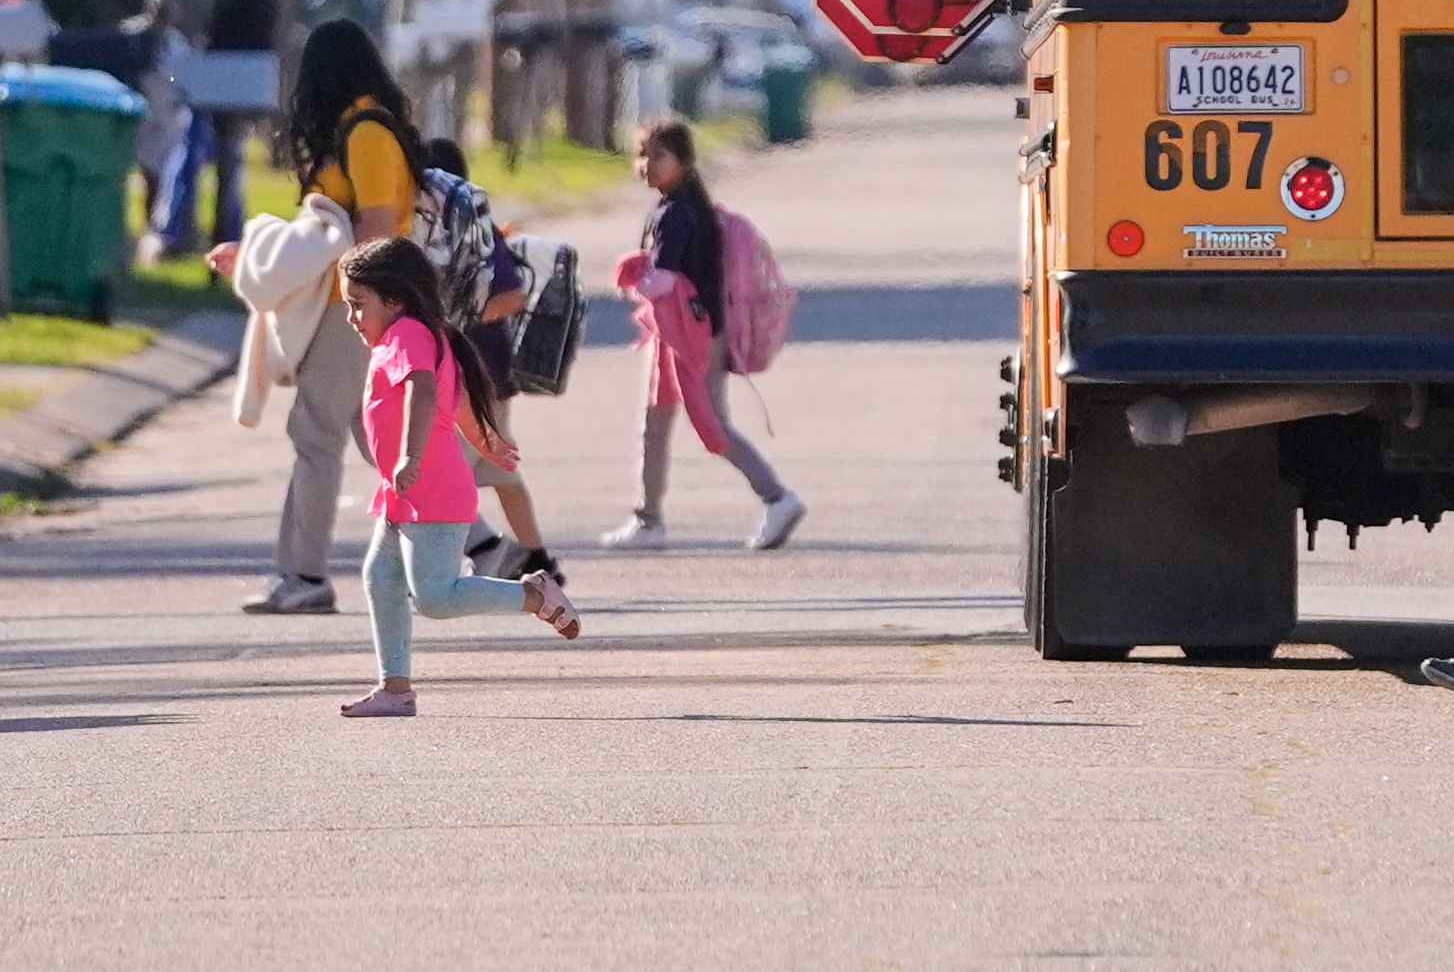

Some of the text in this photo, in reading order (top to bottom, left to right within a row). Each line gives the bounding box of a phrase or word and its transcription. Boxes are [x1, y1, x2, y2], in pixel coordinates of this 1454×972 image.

[1200, 48, 1268, 63] Louisiana
[1177, 64, 1296, 95] A108642
[1196, 95, 1274, 105] SCHOOL BUS
[1144, 119, 1274, 192] 607
[1183, 225, 1287, 249] Thomas
